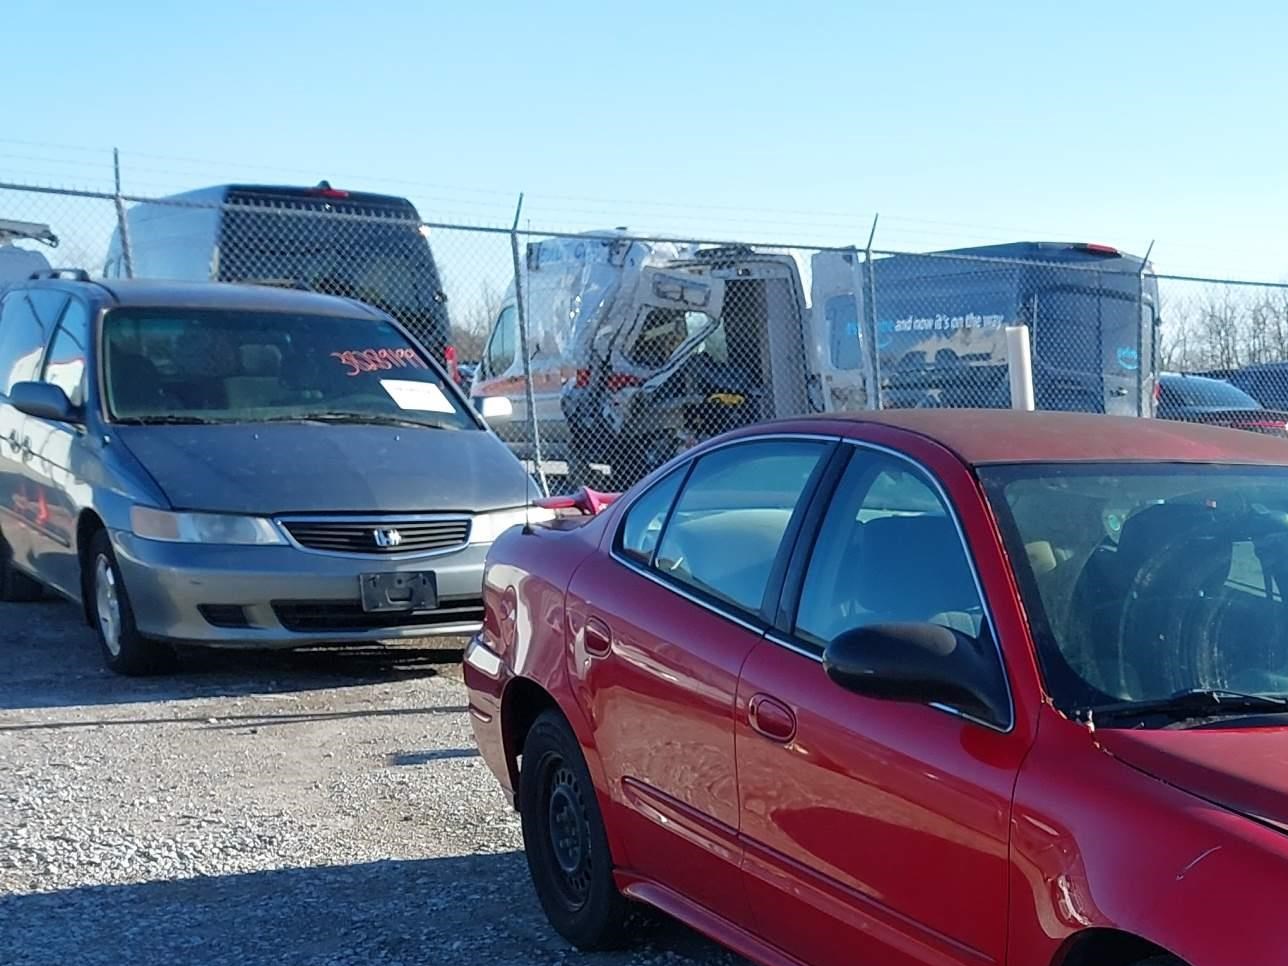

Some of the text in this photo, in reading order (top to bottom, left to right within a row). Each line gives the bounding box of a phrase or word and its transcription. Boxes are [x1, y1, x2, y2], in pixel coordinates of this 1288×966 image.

[895, 315, 913, 331] and
[913, 318, 933, 331] now
[935, 314, 950, 330] it's
[951, 318, 963, 329] on
[965, 313, 982, 328] the
[983, 315, 1004, 330] way
